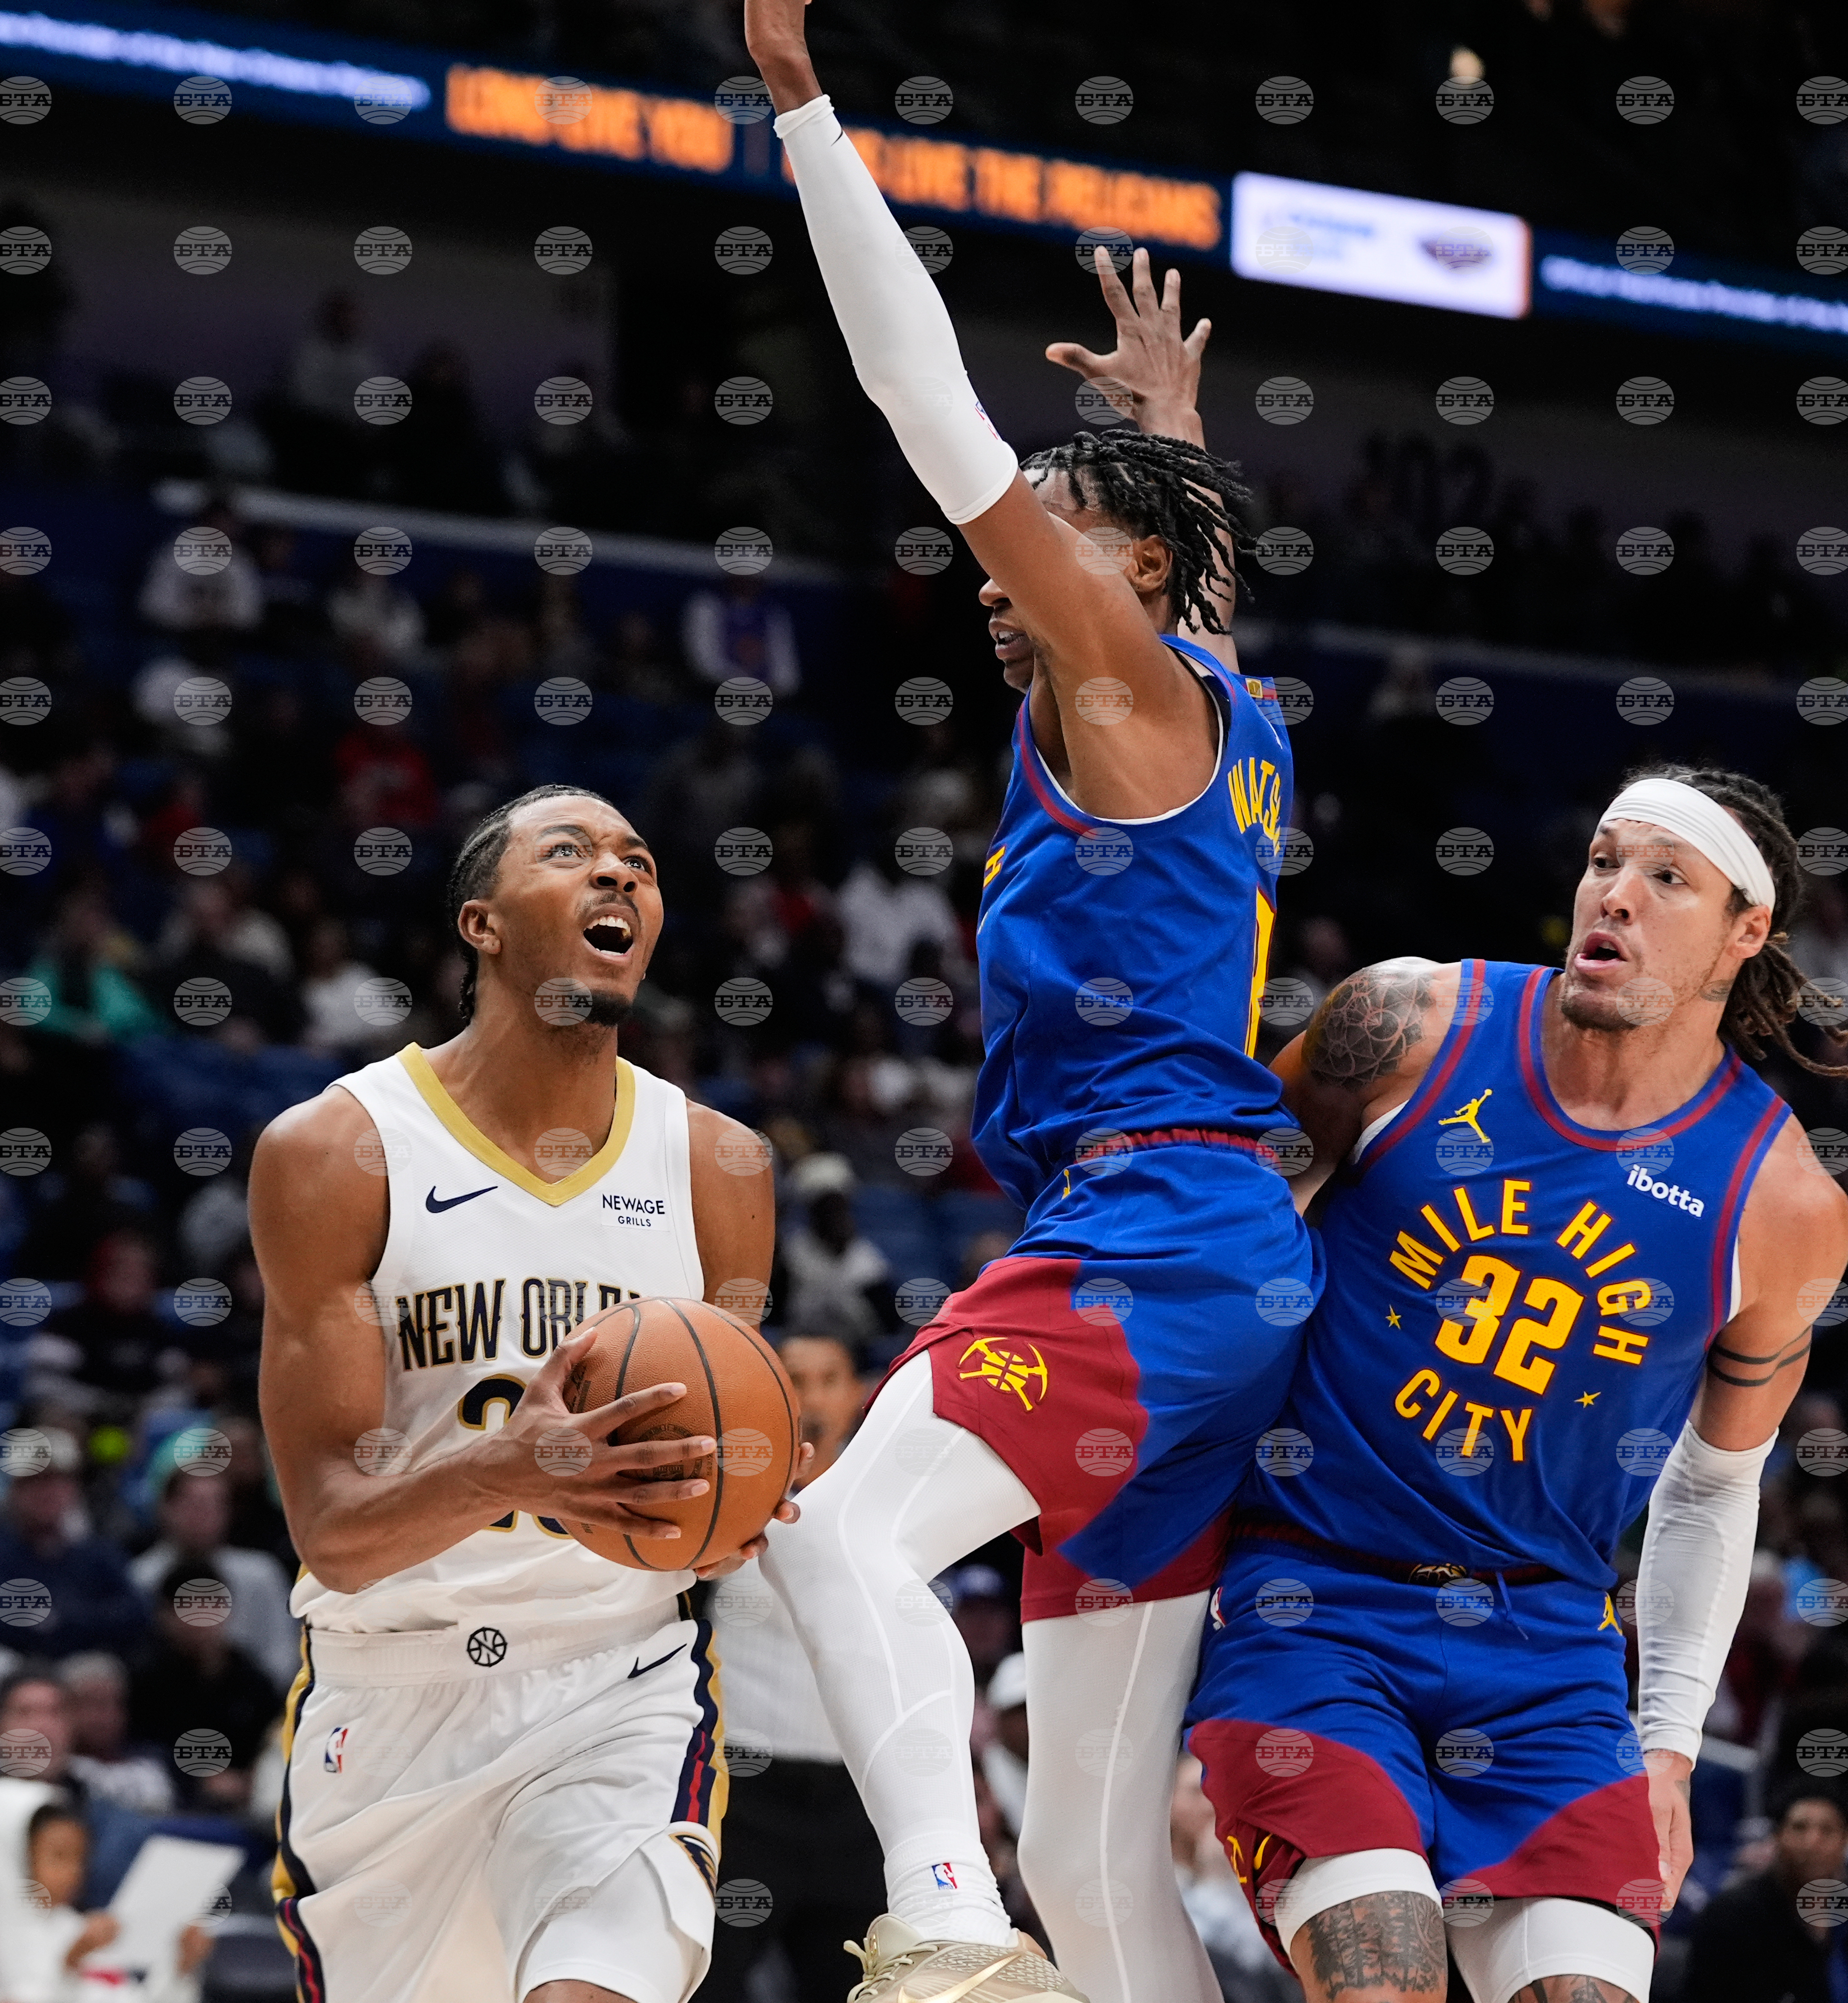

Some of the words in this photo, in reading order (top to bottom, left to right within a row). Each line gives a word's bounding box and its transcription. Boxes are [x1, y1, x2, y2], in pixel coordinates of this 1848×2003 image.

[602, 1193, 665, 1215] NEWAGE
[618, 1215, 652, 1227] GRILLS
[1627, 1164, 1704, 1217] ibotta
[1388, 1179, 1531, 1290] MILE
[1556, 1200, 1652, 1366] HIGH
[395, 1277, 506, 1372] NEW
[520, 1276, 644, 1359] ORL
[1434, 1253, 1585, 1396] 32
[1394, 1368, 1533, 1462] CITY
